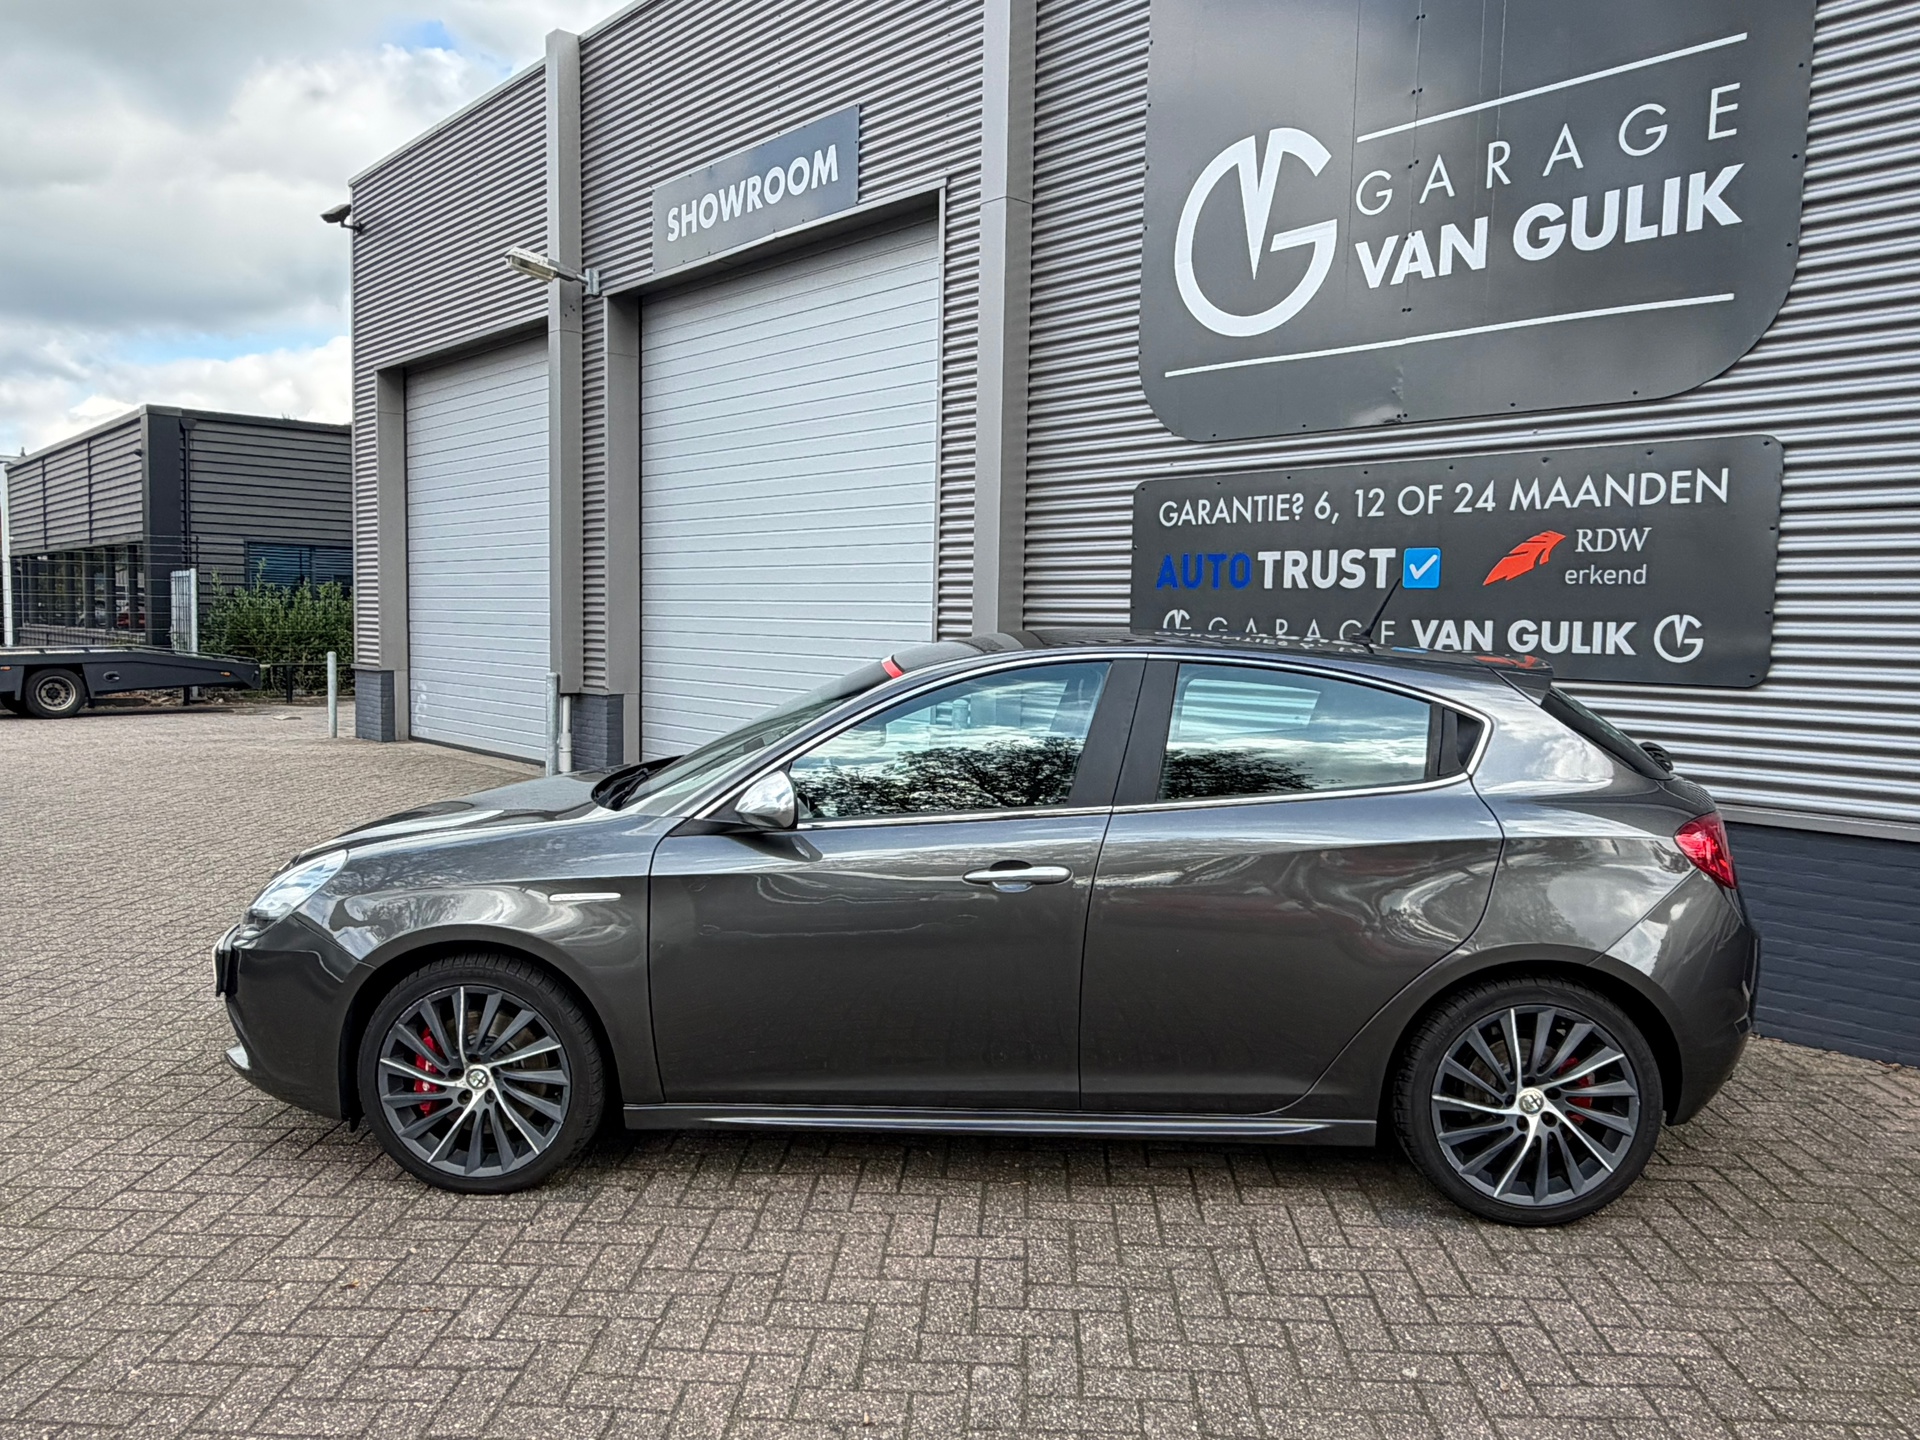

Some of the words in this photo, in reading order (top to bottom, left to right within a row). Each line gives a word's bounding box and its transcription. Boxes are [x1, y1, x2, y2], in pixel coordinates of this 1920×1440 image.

[1355, 82, 1741, 216] GARAGE
[666, 143, 839, 242] SHOWROOM
[1355, 215, 1488, 289] VAN
[1512, 163, 1745, 261] GULIK
[1158, 492, 1304, 527] GARANTIE?
[1313, 490, 1340, 525] 6,
[1354, 487, 1385, 518] 12
[1397, 484, 1444, 516] OF
[1453, 479, 1496, 513] 24
[1509, 467, 1729, 511] MAANDEN
[1574, 527, 1653, 553] RDW
[1564, 563, 1648, 585] erkend
[1411, 619, 1494, 651] VAN
[1507, 619, 1637, 656] GULIK
